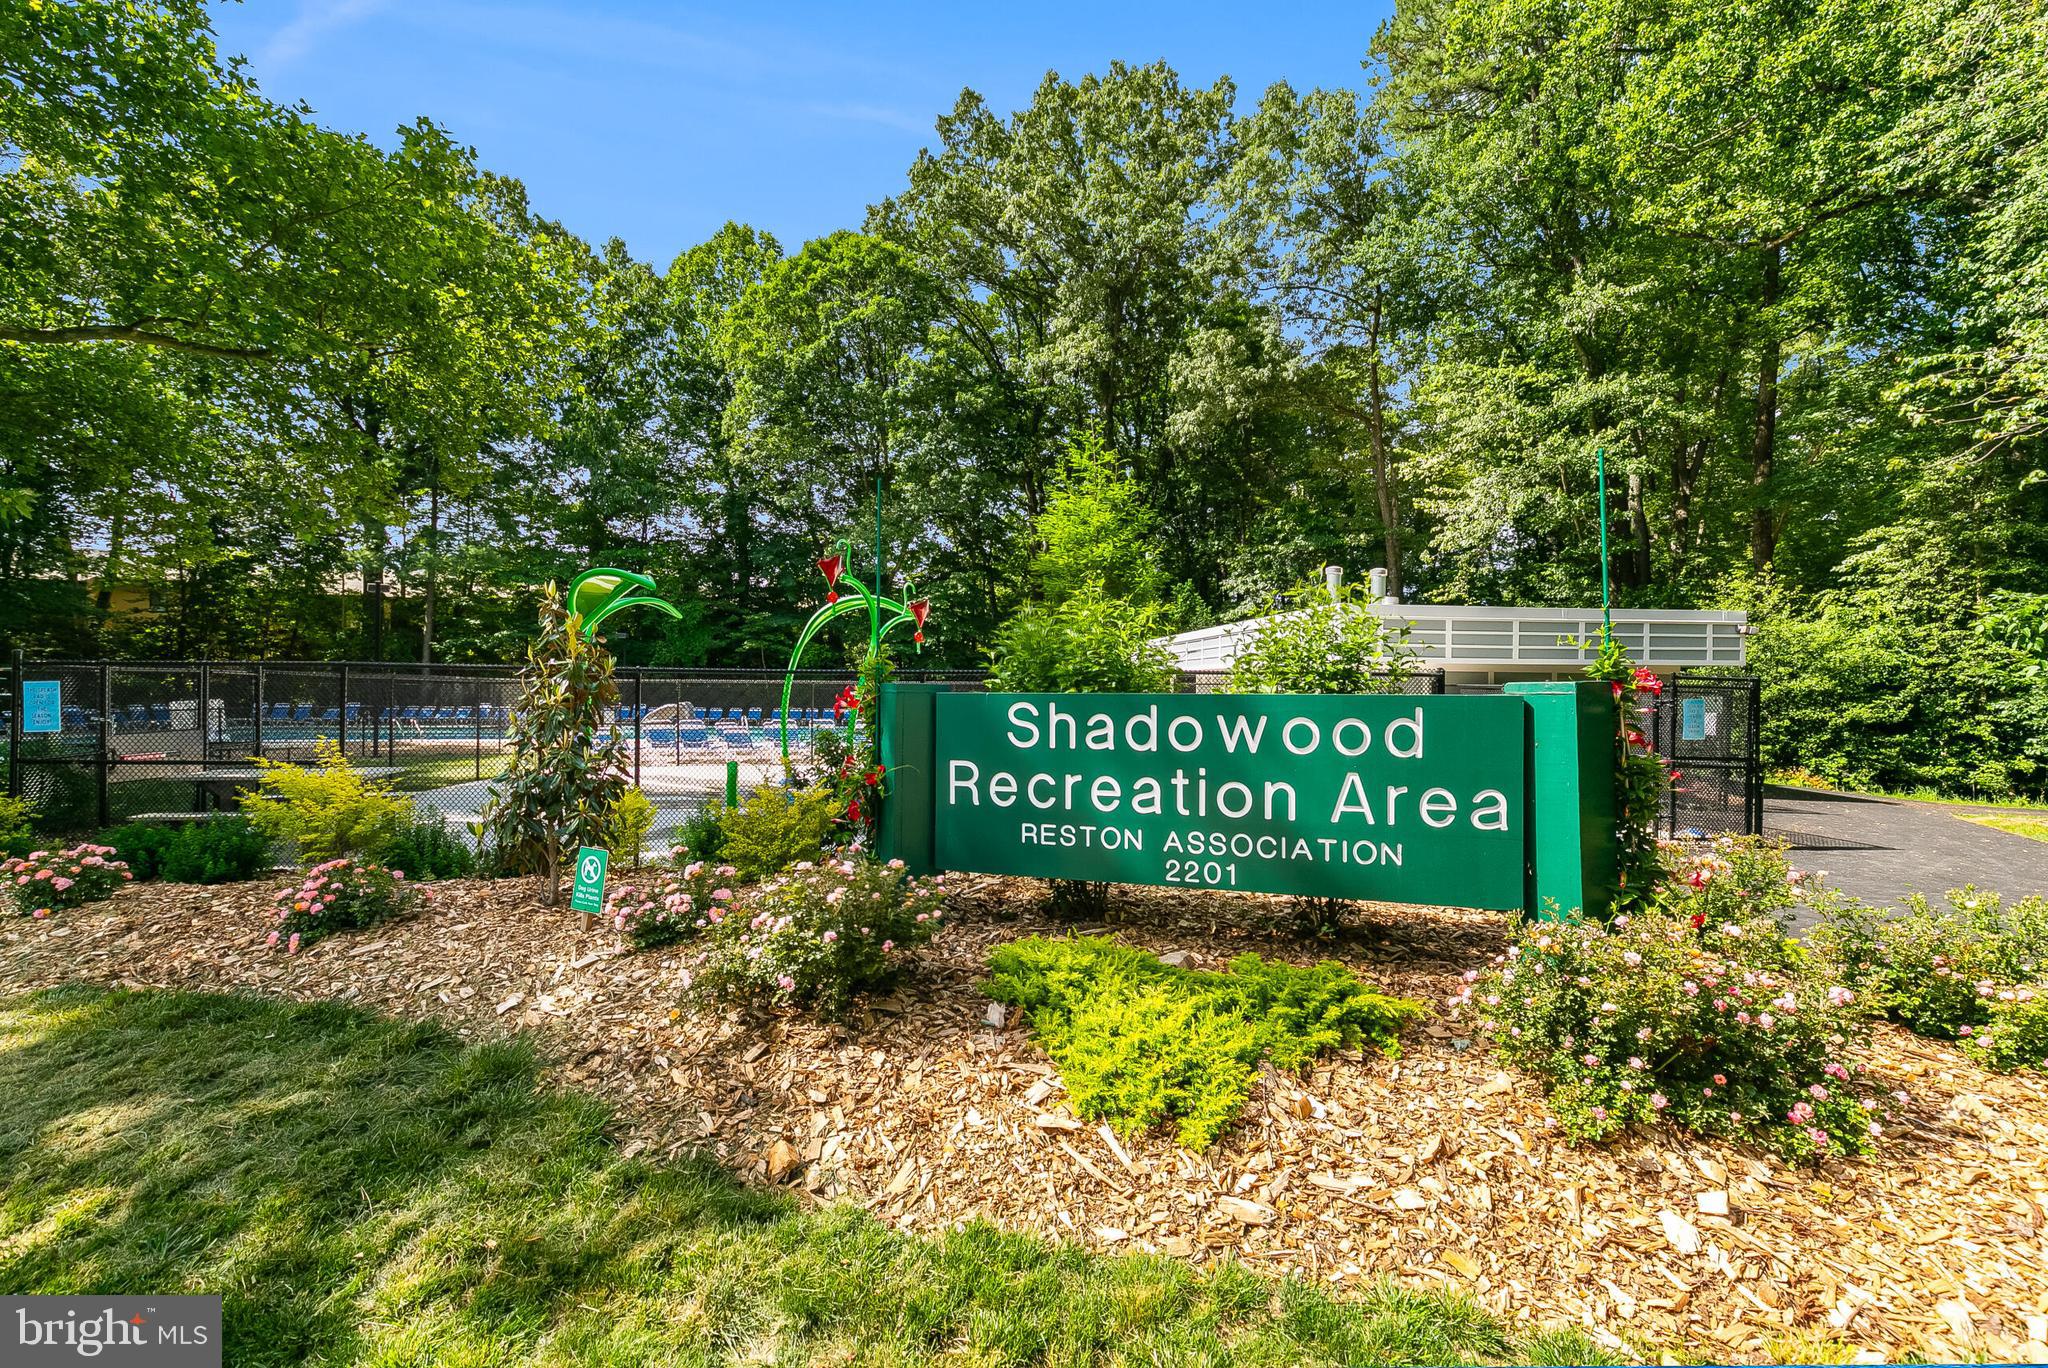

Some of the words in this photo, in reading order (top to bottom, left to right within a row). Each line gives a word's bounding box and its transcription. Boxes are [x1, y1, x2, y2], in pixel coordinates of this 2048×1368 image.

[1007, 701, 1424, 759] Shadowood
[949, 759, 1296, 822] Recreation
[1330, 772, 1509, 832] Area
[1021, 822, 1143, 851] RESTON
[1162, 830, 1403, 866] ASSOCIATION
[1165, 859, 1236, 886] 2201
